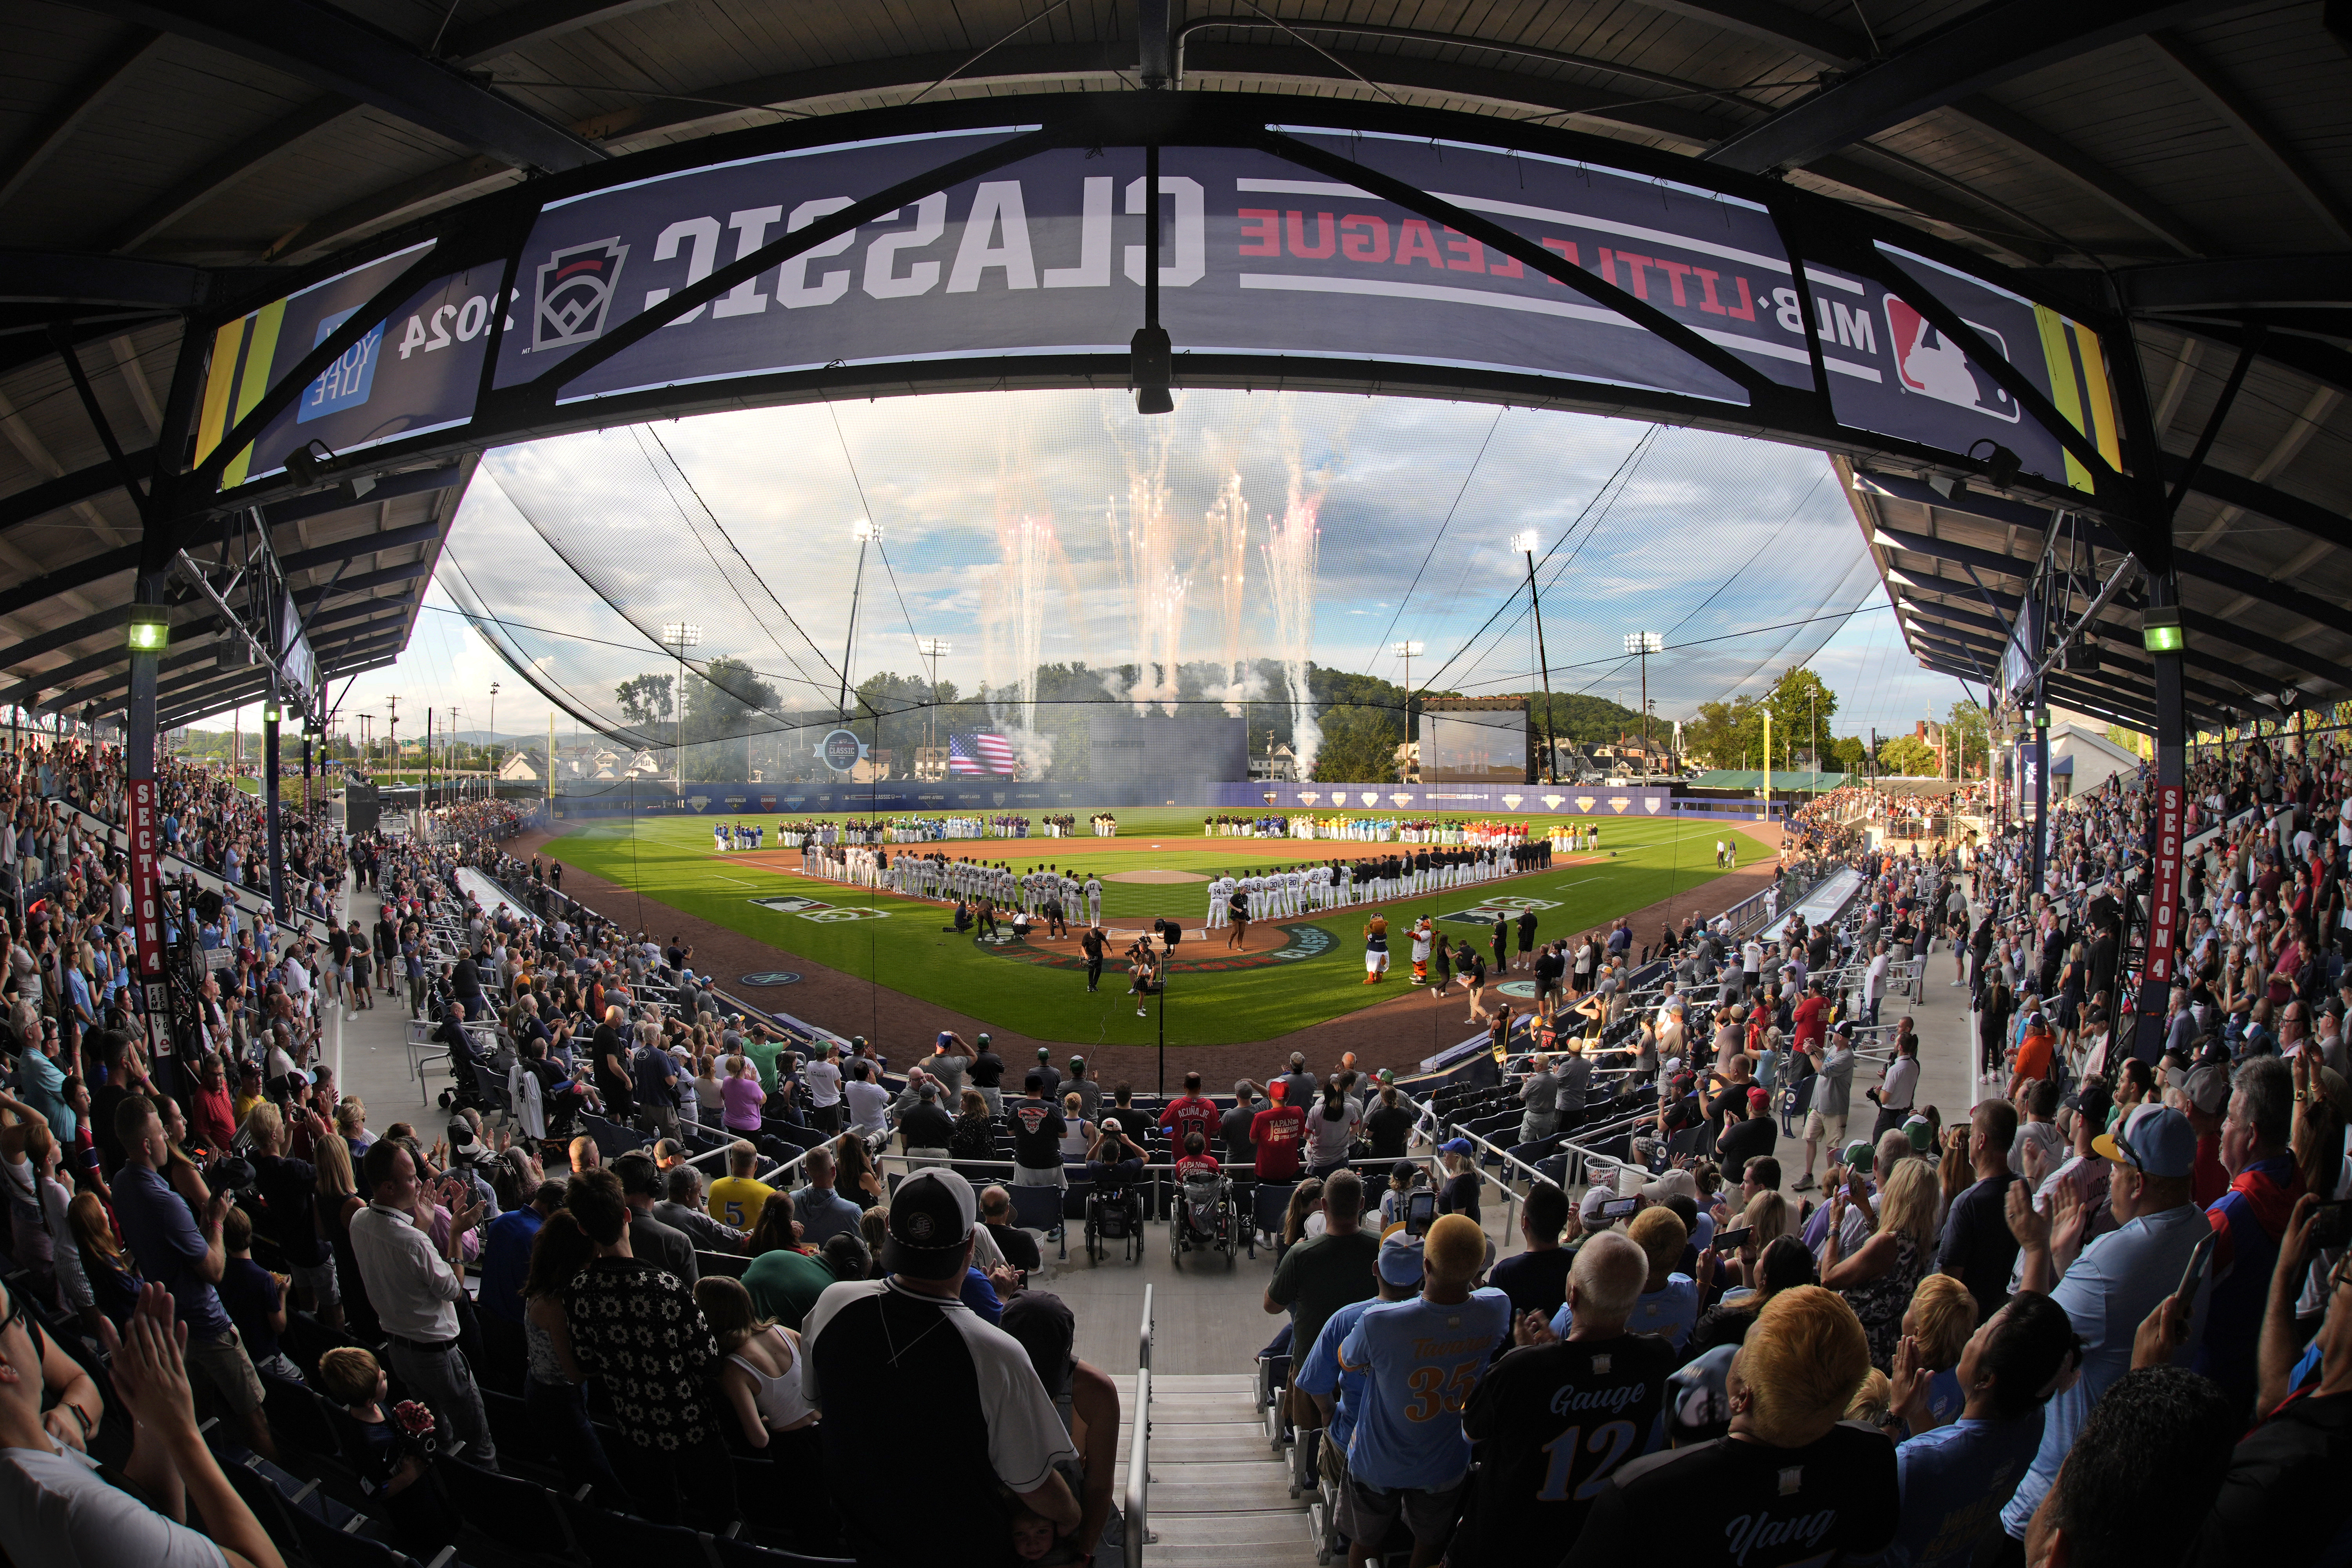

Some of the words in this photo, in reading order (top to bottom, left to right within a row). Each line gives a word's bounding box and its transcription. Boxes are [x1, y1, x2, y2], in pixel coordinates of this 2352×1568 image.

[138, 785, 157, 941] SECTION
[149, 952, 160, 970] 4
[2156, 791, 2176, 948] SECTION
[574, 933, 581, 941] 48
[1111, 956, 1281, 971] LAGUE
[1274, 928, 1329, 959] CLASSIC
[2153, 960, 2164, 978] 4
[151, 988, 160, 1030] FAMILY
[1541, 1036, 1552, 1047] 26
[1178, 1106, 1199, 1118] ACUÑA
[1200, 1109, 1209, 1119] JR.
[1181, 1119, 1205, 1139] 13
[1268, 1119, 1292, 1141] JAPAN
[1274, 1125, 1299, 1134] CHAMPIONS
[725, 1201, 744, 1229] 5
[1405, 1357, 1481, 1423] 35
[1550, 1382, 1646, 1416] Gauge
[1536, 1420, 1637, 1502] 12
[1726, 1508, 1838, 1566] Yang
